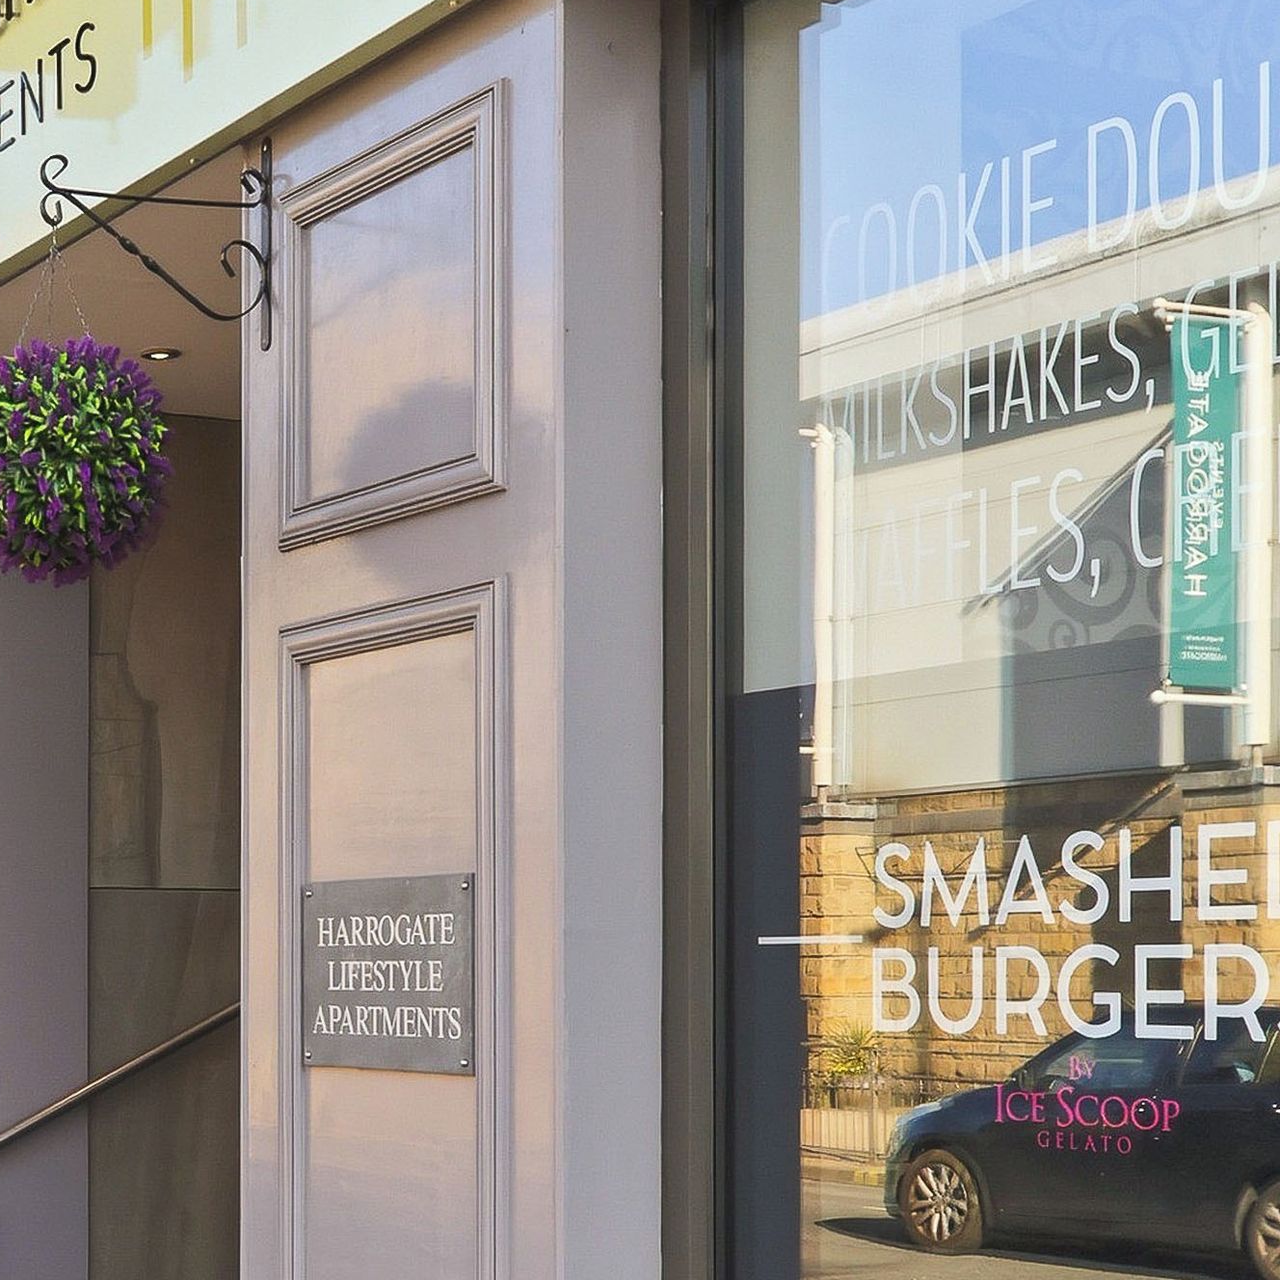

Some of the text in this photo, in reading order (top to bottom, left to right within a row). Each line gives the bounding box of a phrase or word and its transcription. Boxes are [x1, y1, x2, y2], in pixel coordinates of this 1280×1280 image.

[1087, 61, 1270, 252] DOU
[850, 467, 1102, 606] AFFLES,
[873, 821, 1280, 928] SMASHE
[317, 913, 455, 947] HARROGATE
[328, 960, 444, 992] LIFESTYLE
[872, 943, 1280, 1042] BURGER
[313, 1005, 462, 1040] APARTMENTS
[1037, 1130, 1132, 1154] GELATO
